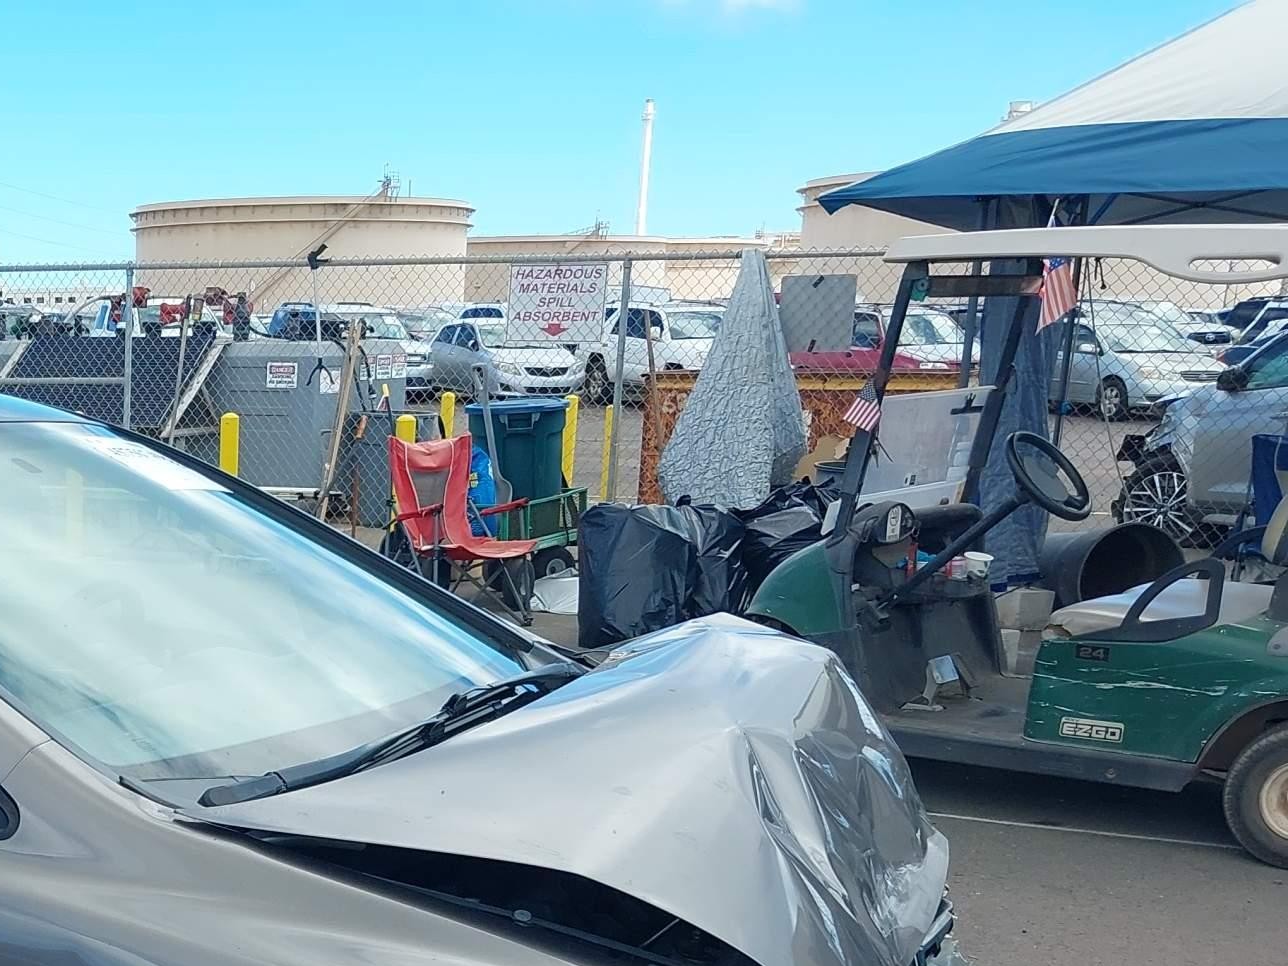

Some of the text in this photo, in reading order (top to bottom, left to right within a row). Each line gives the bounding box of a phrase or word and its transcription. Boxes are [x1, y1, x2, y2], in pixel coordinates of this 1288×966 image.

[515, 268, 603, 280] HAZARDOUS
[518, 282, 598, 294] MATERIALS
[537, 296, 576, 308] SPILL
[512, 311, 600, 322] ABSORBENT
[1079, 647, 1105, 659] 24
